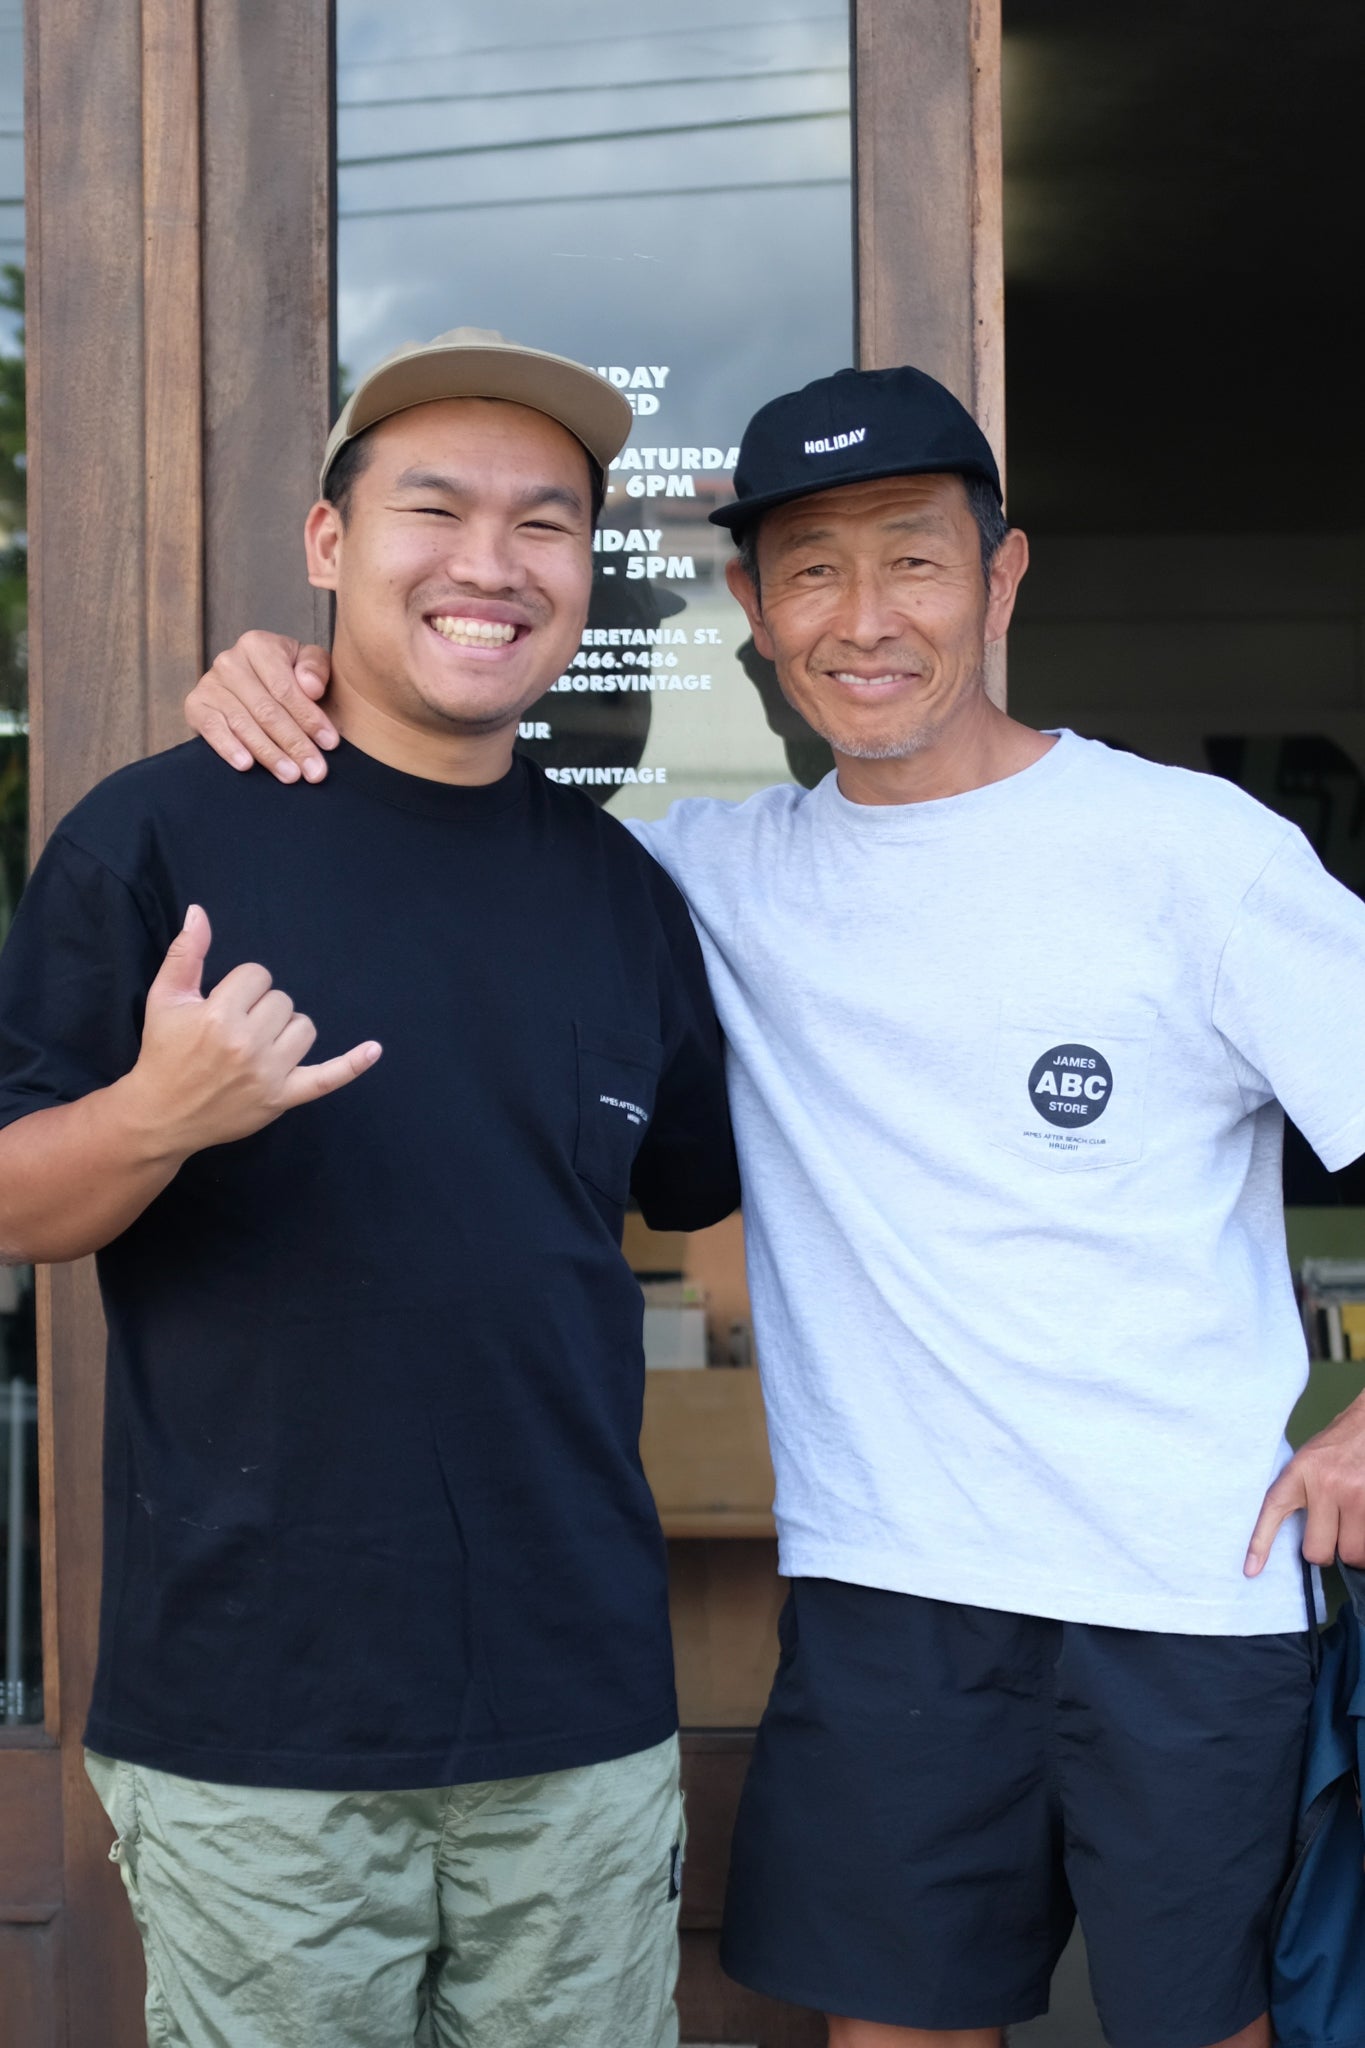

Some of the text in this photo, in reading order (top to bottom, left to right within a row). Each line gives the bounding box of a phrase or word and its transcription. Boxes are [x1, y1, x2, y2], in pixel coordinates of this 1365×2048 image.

[804, 427, 866, 454] HOLIDAY
[625, 475, 696, 498] 6PM
[603, 555, 696, 579] - 5PM
[693, 628, 722, 645] ST.
[1052, 1055, 1097, 1069] JAMES
[1034, 1070, 1108, 1101] ABC
[1048, 1101, 1089, 1115] STORE
[1023, 1131, 1042, 1139] JAMES
[1043, 1133, 1064, 1141] AFTER
[1065, 1136, 1088, 1144] BEACH
[1048, 1142, 1079, 1151] HAWAII
